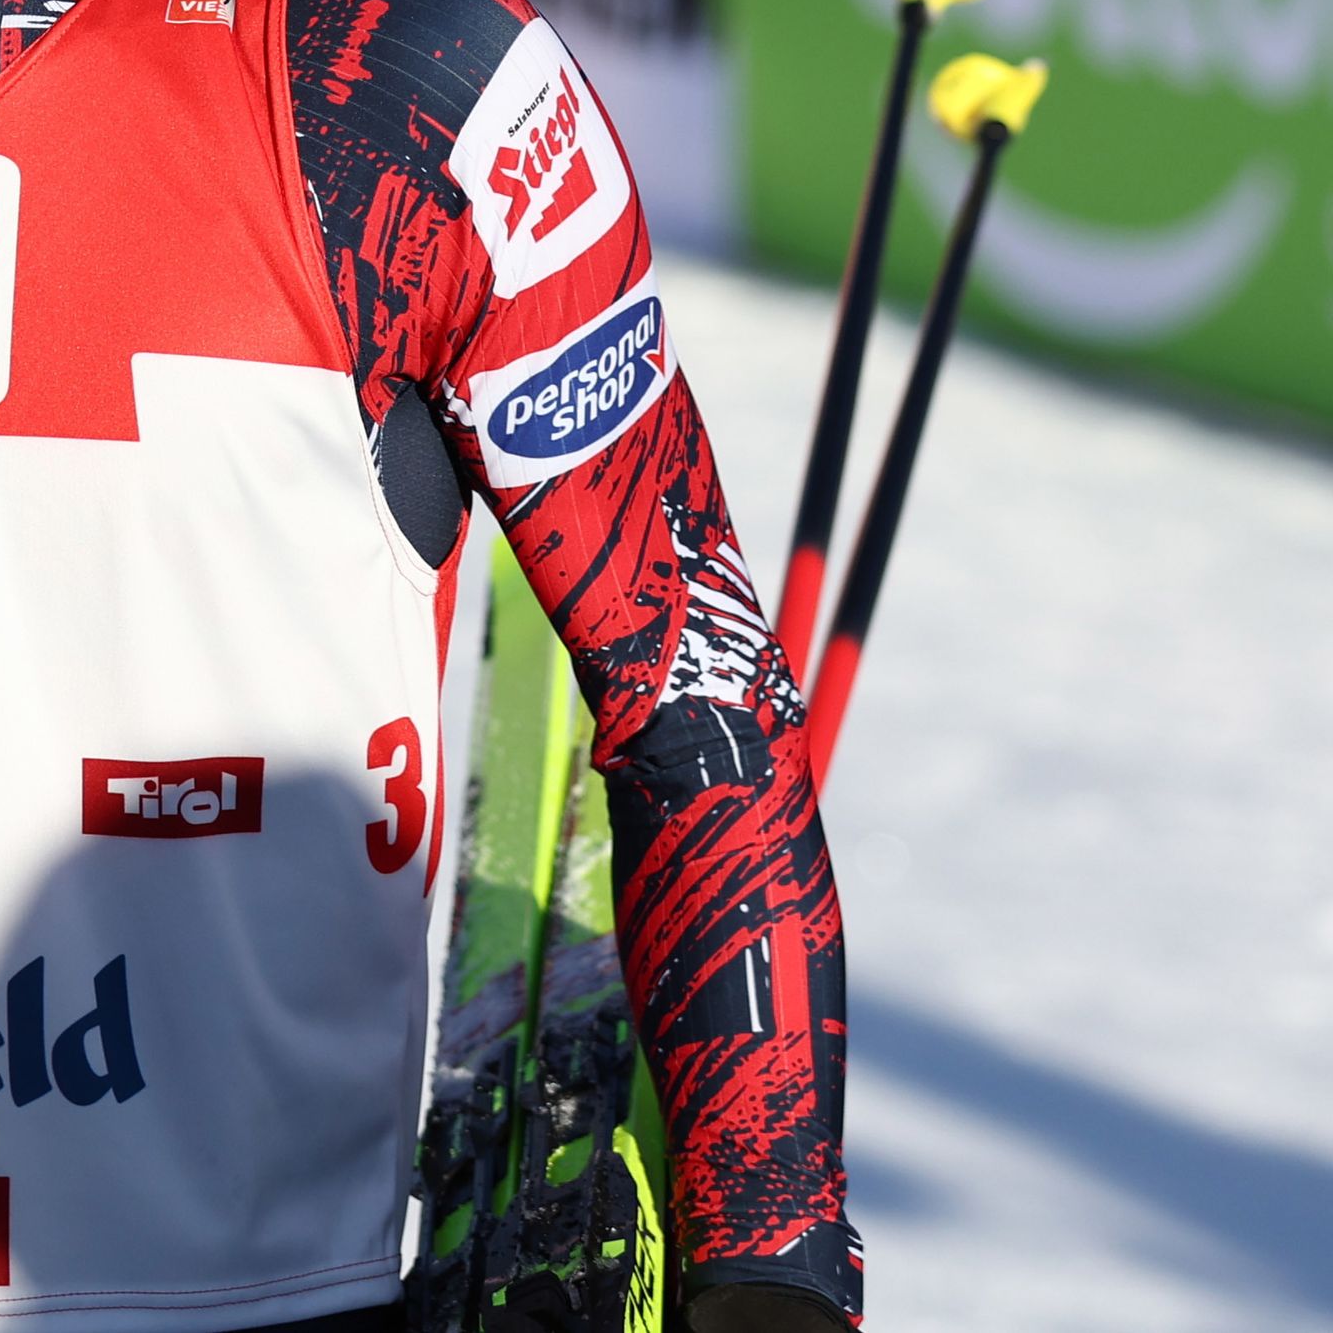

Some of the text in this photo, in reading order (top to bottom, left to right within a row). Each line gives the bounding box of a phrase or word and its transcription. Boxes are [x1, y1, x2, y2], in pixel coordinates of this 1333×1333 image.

[488, 64, 580, 243] Stiegl
[506, 301, 655, 435] personal
[550, 362, 636, 441] shop
[107, 771, 237, 826] Tirol
[365, 716, 427, 875] 3
